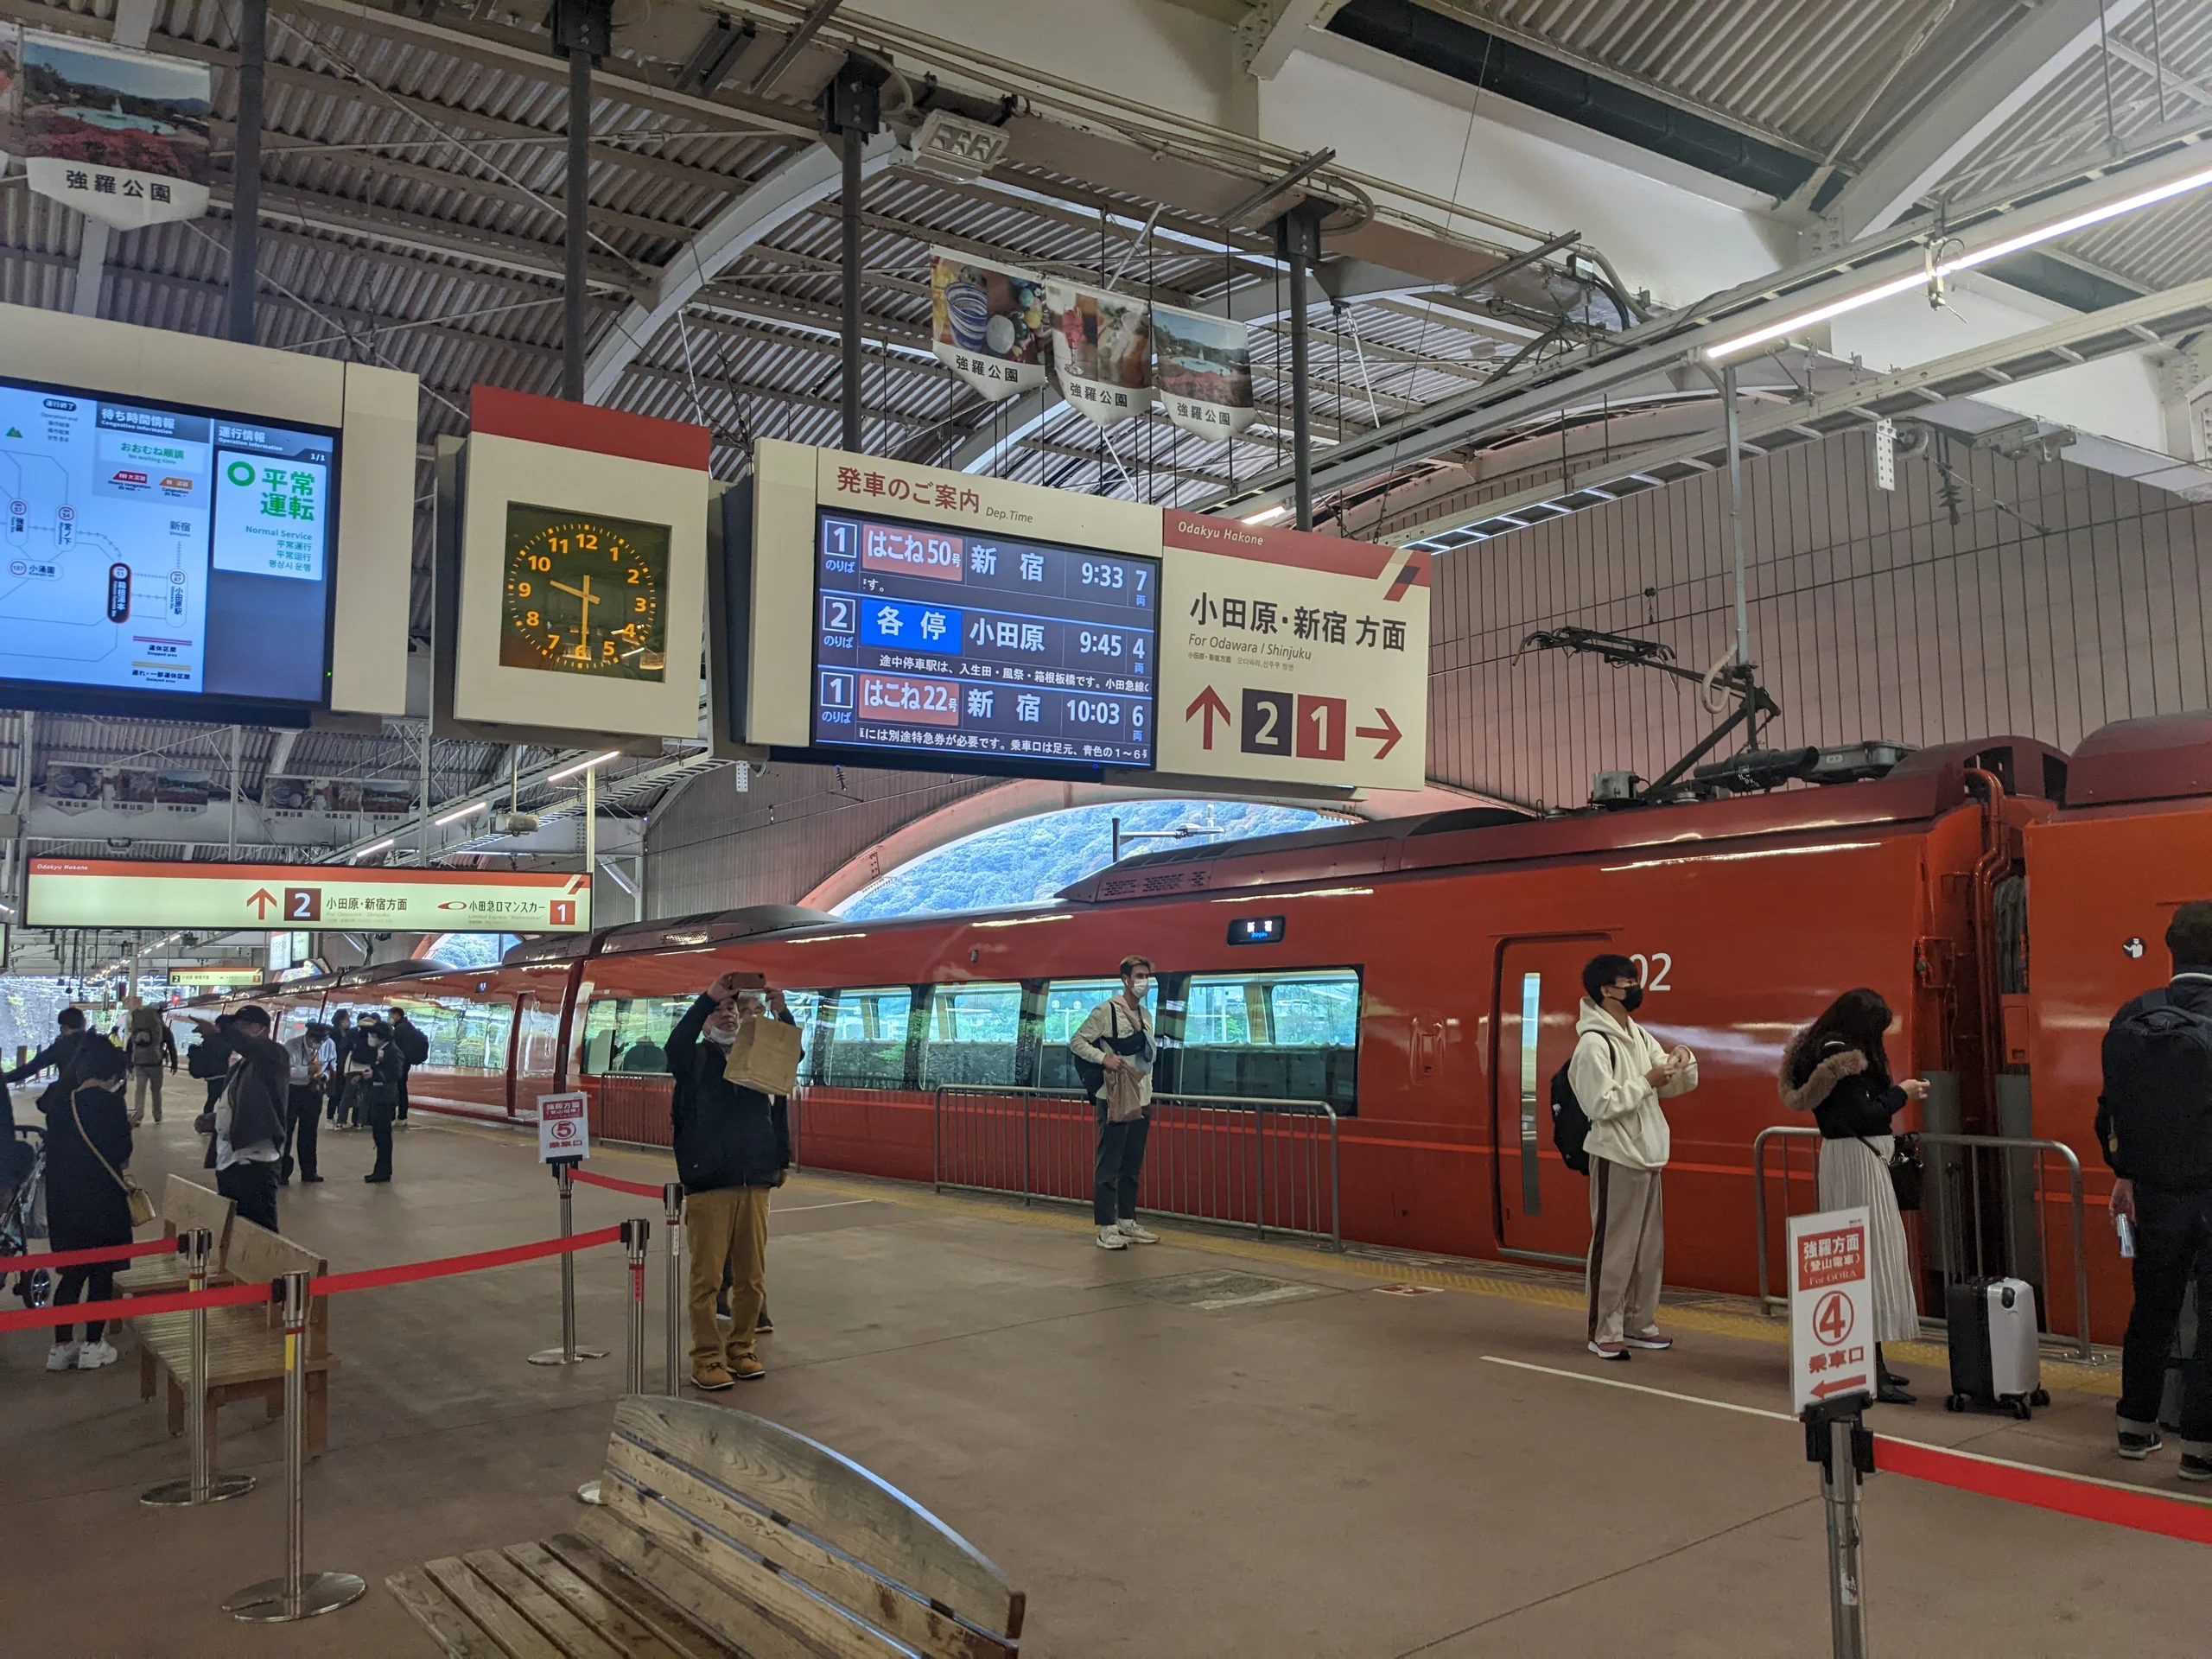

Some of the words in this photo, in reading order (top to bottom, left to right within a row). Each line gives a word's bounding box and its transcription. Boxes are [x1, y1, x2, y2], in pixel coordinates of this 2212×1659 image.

[67, 169, 171, 204] 強羅公園
[956, 354, 1019, 383] 強羅公園
[1070, 382, 1128, 408] 強羅公園
[102, 408, 175, 429] 待ち時間情報
[1177, 402, 1230, 426] 強羅公園
[101, 420, 136, 429] Congestion
[137, 425, 173, 435] Information
[219, 426, 266, 442] 運行情報
[121, 442, 184, 460] おおむね順調
[219, 437, 248, 447] Operation
[249, 442, 283, 451] Information
[310, 453, 326, 461] 1/1
[262, 467, 315, 496] 平常
[836, 466, 980, 514] 発車のご案内
[261, 493, 315, 521] 運転
[985, 506, 1033, 524] Dep.Time
[170, 520, 191, 532] 新宿
[245, 525, 279, 537] Normal
[281, 530, 313, 540] Service
[1178, 521, 1220, 539] Odakyu
[1224, 528, 1264, 546] Hakone
[549, 537, 569, 554] 11
[576, 532, 598, 550] 12
[834, 527, 846, 552] 1
[609, 546, 619, 562] 1
[528, 555, 551, 572] 10
[825, 559, 855, 574] のりば
[627, 569, 639, 584] 2
[1082, 562, 1123, 589] 9:33
[1135, 569, 1147, 592] 7
[518, 582, 532, 598] 9
[634, 597, 647, 613] 3
[1135, 594, 1146, 607] 両
[526, 611, 540, 626] 8
[830, 602, 849, 628] 2
[623, 623, 637, 639] 4
[969, 617, 1046, 652] 小田原
[548, 634, 560, 650] 7
[603, 641, 615, 657] 5
[823, 635, 854, 650] のりば
[1079, 631, 1122, 657] 9:45
[1132, 638, 1146, 659] 4
[1188, 632, 1205, 646] For
[1209, 636, 1258, 654] Odawara
[1267, 644, 1312, 661] Shinjuku
[575, 645, 587, 658] 6
[1134, 663, 1145, 674] 両
[830, 678, 842, 703] 1
[822, 710, 852, 725] のりば
[1066, 699, 1120, 726] 10:03
[1132, 705, 1144, 727] 6
[1133, 730, 1143, 741] 両
[1255, 701, 1279, 746] 2
[1310, 705, 1328, 752] 1
[293, 892, 312, 918] 2
[326, 897, 408, 912] 小田原・新宿方面
[469, 900, 546, 913] 小田急ロマンスカー
[556, 904, 566, 922] 1
[1803, 1233, 1859, 1260] 強羅方面
[1809, 1276, 1824, 1286] For
[1827, 1270, 1858, 1282] GORA
[1808, 1345, 1865, 1374] 乗車口
